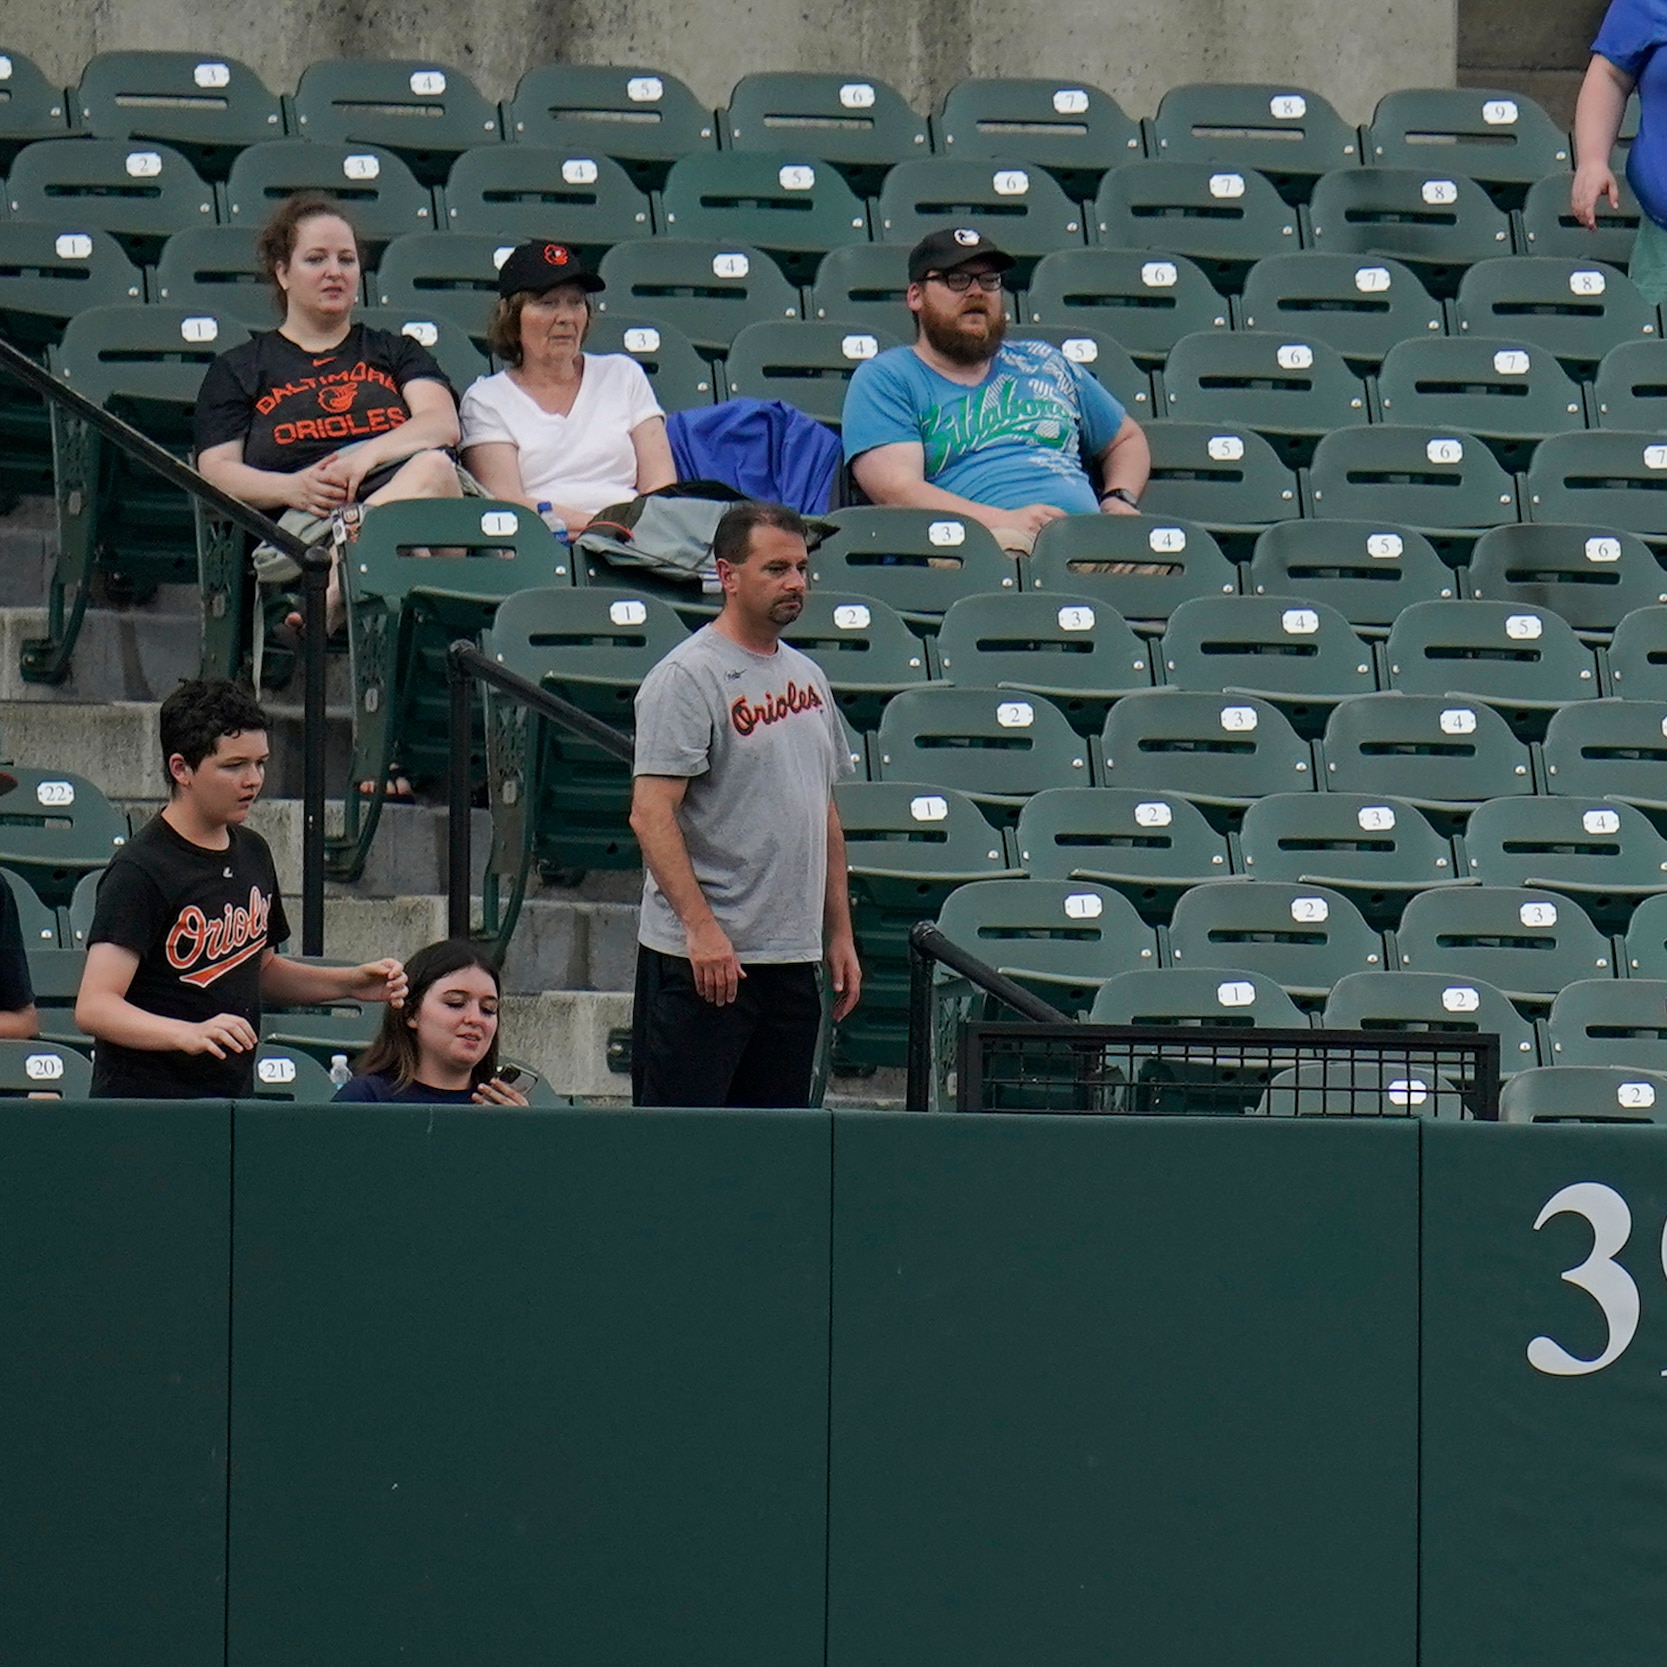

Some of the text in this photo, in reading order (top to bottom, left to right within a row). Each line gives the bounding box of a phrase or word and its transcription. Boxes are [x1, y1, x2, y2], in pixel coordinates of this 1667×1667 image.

[423, 75, 432, 90] 4
[641, 82, 650, 98] 5
[852, 89, 863, 102] 6
[1066, 93, 1075, 108] 7
[1283, 100, 1293, 114] 8
[1495, 105, 1505, 119] 9
[139, 156, 148, 173] 2
[358, 158, 367, 173] 3
[575, 164, 584, 178] 4
[793, 170, 801, 185] 5
[1006, 175, 1016, 189] 6
[1222, 178, 1231, 193] 7
[1435, 185, 1445, 199] 8
[726, 258, 735, 272] 4
[1155, 267, 1165, 282] 6
[1367, 272, 1376, 287] 7
[1582, 276, 1592, 290] 8
[638, 333, 646, 348] 3
[855, 339, 864, 354] 4
[1075, 343, 1084, 358] 5
[1290, 349, 1300, 363] 6
[1506, 355, 1516, 370] 7
[273, 407, 408, 445] ORIOLES
[1221, 441, 1230, 456] 5
[1440, 443, 1450, 458] 6
[1656, 449, 1666, 464] 7
[943, 526, 951, 542] 3
[1162, 532, 1172, 547] 4
[1381, 538, 1390, 554] 5
[1598, 542, 1609, 557] 6
[847, 609, 857, 624] 2
[1072, 611, 1081, 626] 3
[1296, 614, 1305, 629] 4
[1519, 619, 1528, 635] 5
[731, 679, 824, 737] Orioles
[1010, 707, 1020, 723] 2
[1234, 711, 1244, 727] 3
[1453, 714, 1463, 729] 4
[45, 785, 66, 801] 22
[1148, 807, 1159, 822] 2
[1372, 811, 1381, 826] 3
[1596, 814, 1606, 829] 4
[1305, 902, 1315, 918] 2
[1534, 907, 1543, 923] 3
[1456, 992, 1466, 1007] 2
[35, 1060, 55, 1075] 20
[267, 1062, 284, 1078] 21
[1632, 1087, 1641, 1103] 2
